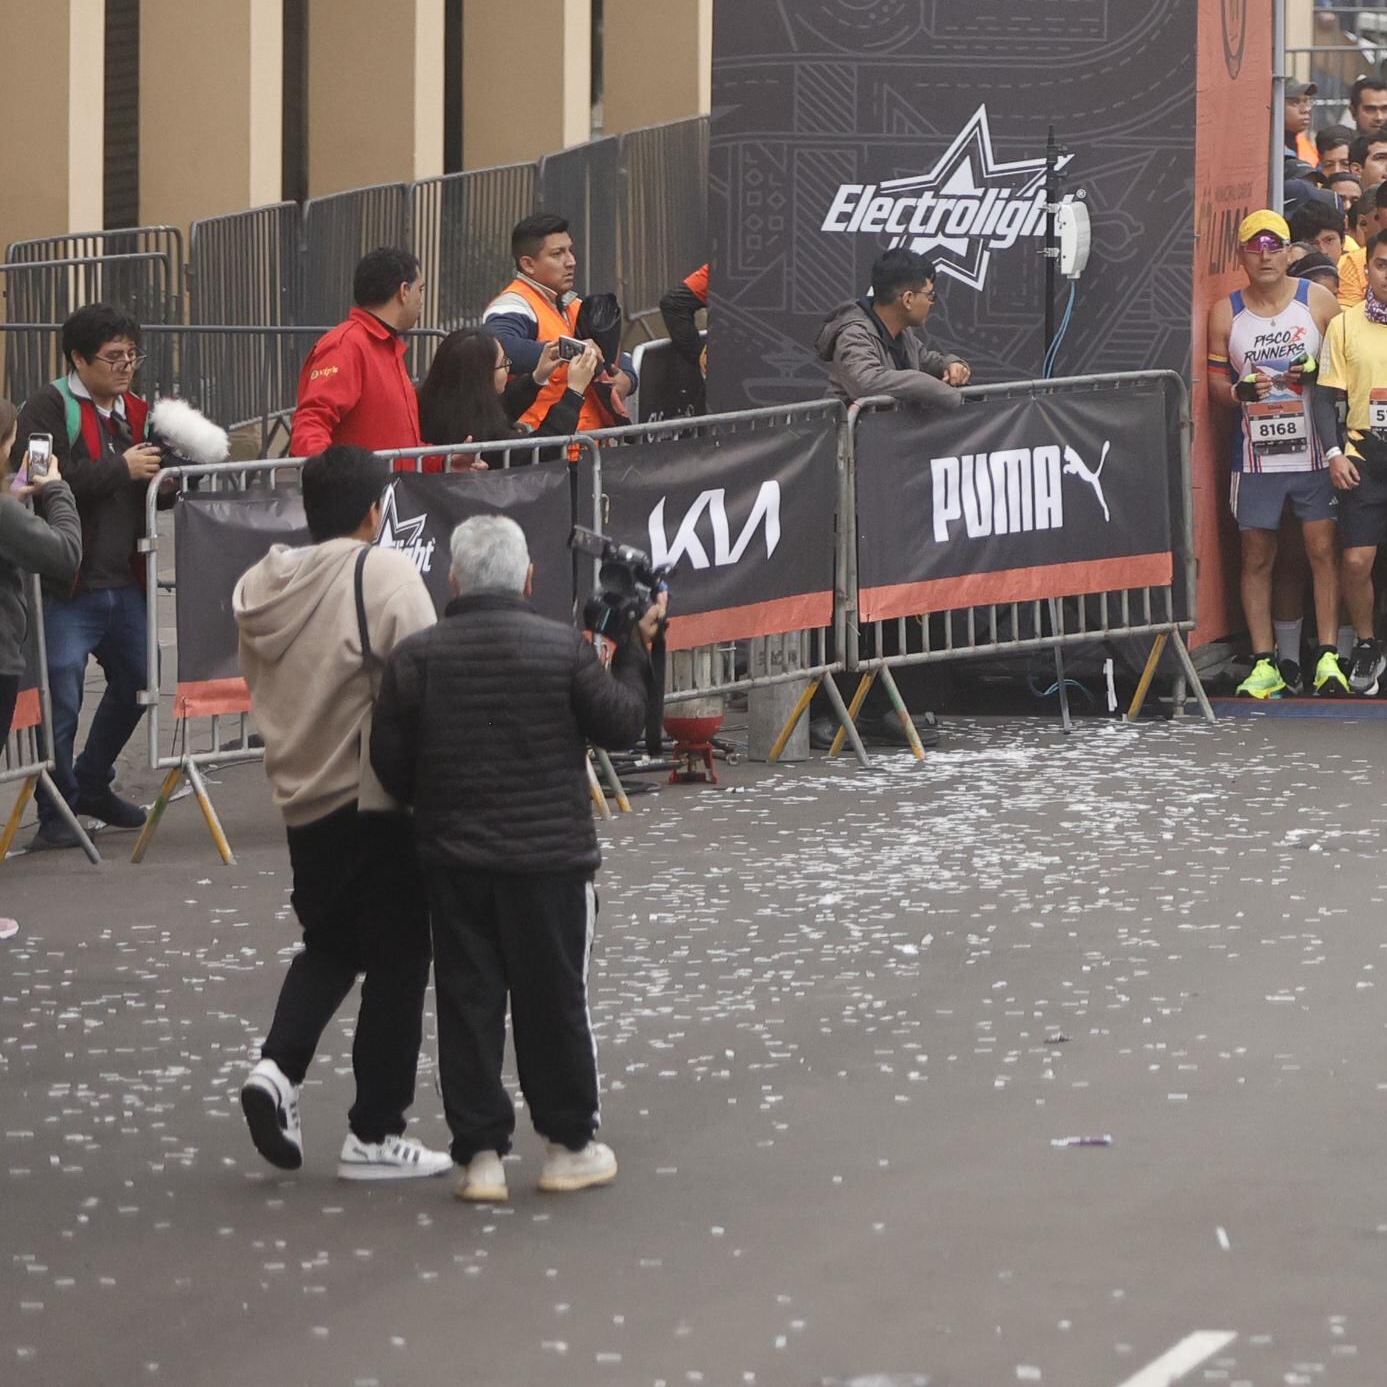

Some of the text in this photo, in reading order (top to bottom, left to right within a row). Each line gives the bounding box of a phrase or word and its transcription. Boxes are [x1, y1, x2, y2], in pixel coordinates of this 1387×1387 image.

[1208, 207, 1248, 275] LIM
[1244, 342, 1305, 364] RUNNERS
[1254, 331, 1291, 348] PISCO
[1260, 422, 1297, 437] 8168
[930, 444, 1064, 543] PUMA
[647, 480, 781, 570] KIA
